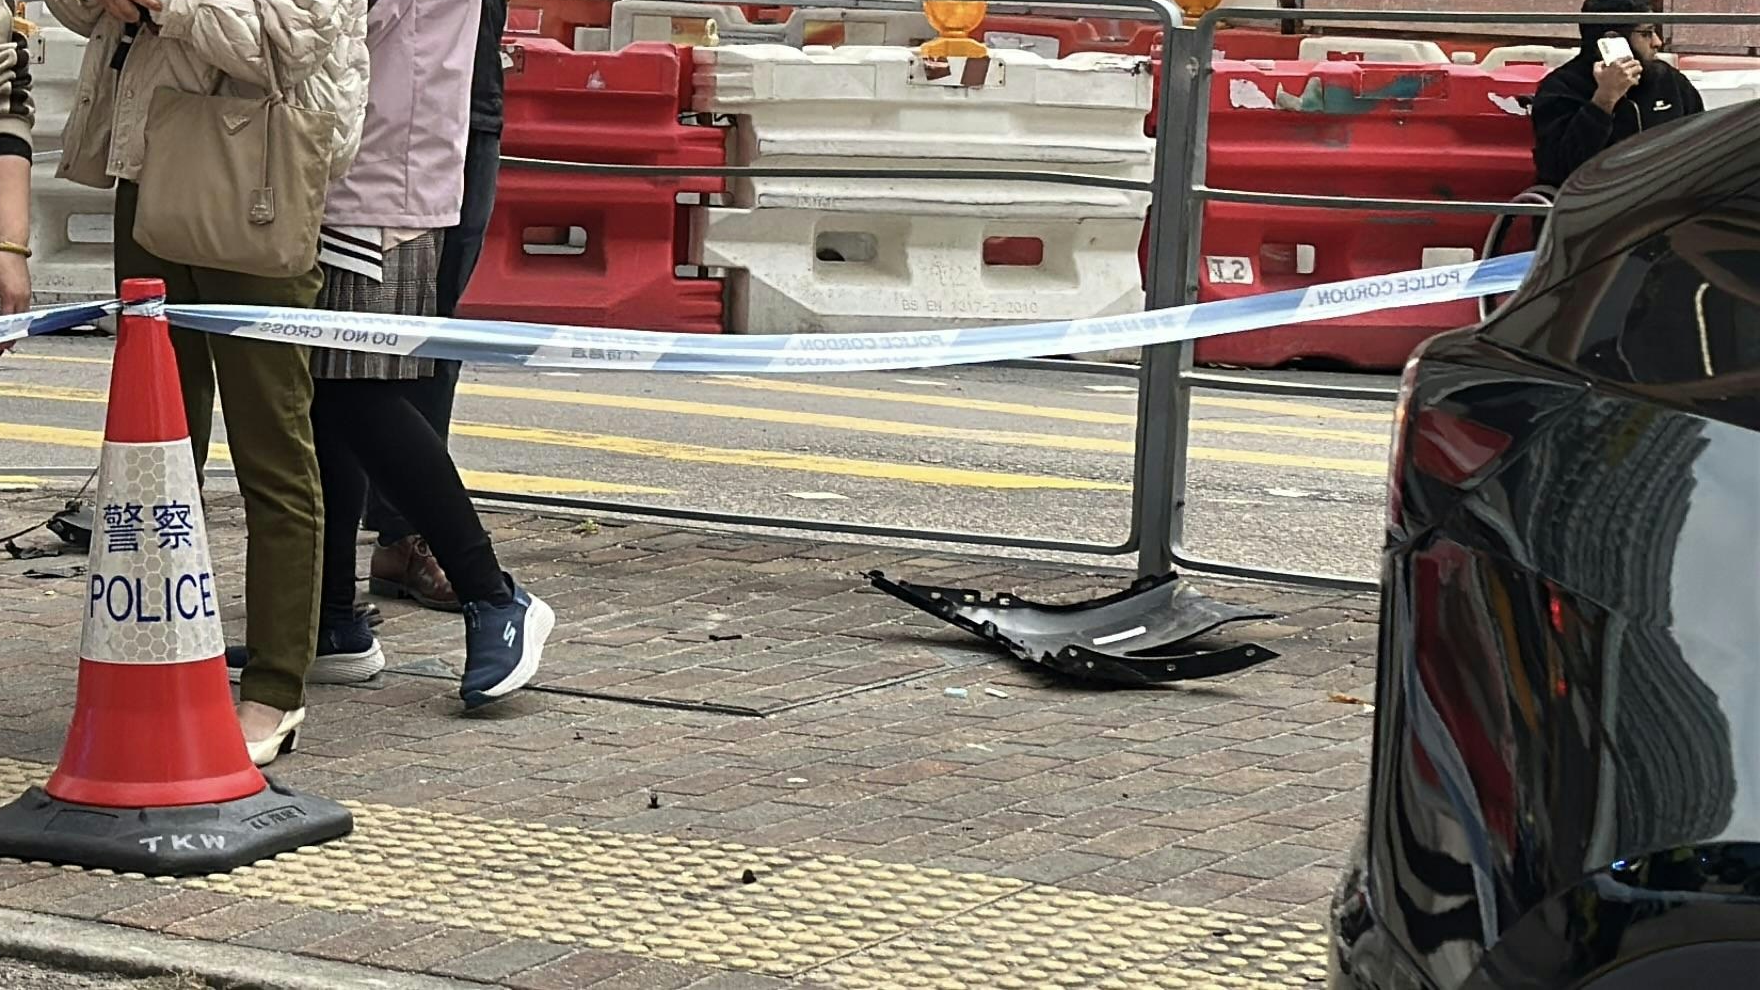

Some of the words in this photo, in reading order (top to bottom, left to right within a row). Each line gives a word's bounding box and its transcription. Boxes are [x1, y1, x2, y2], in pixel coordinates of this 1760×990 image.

[103, 499, 194, 554] 警察
[90, 572, 216, 623] POLICE
[139, 833, 226, 853] TKW
